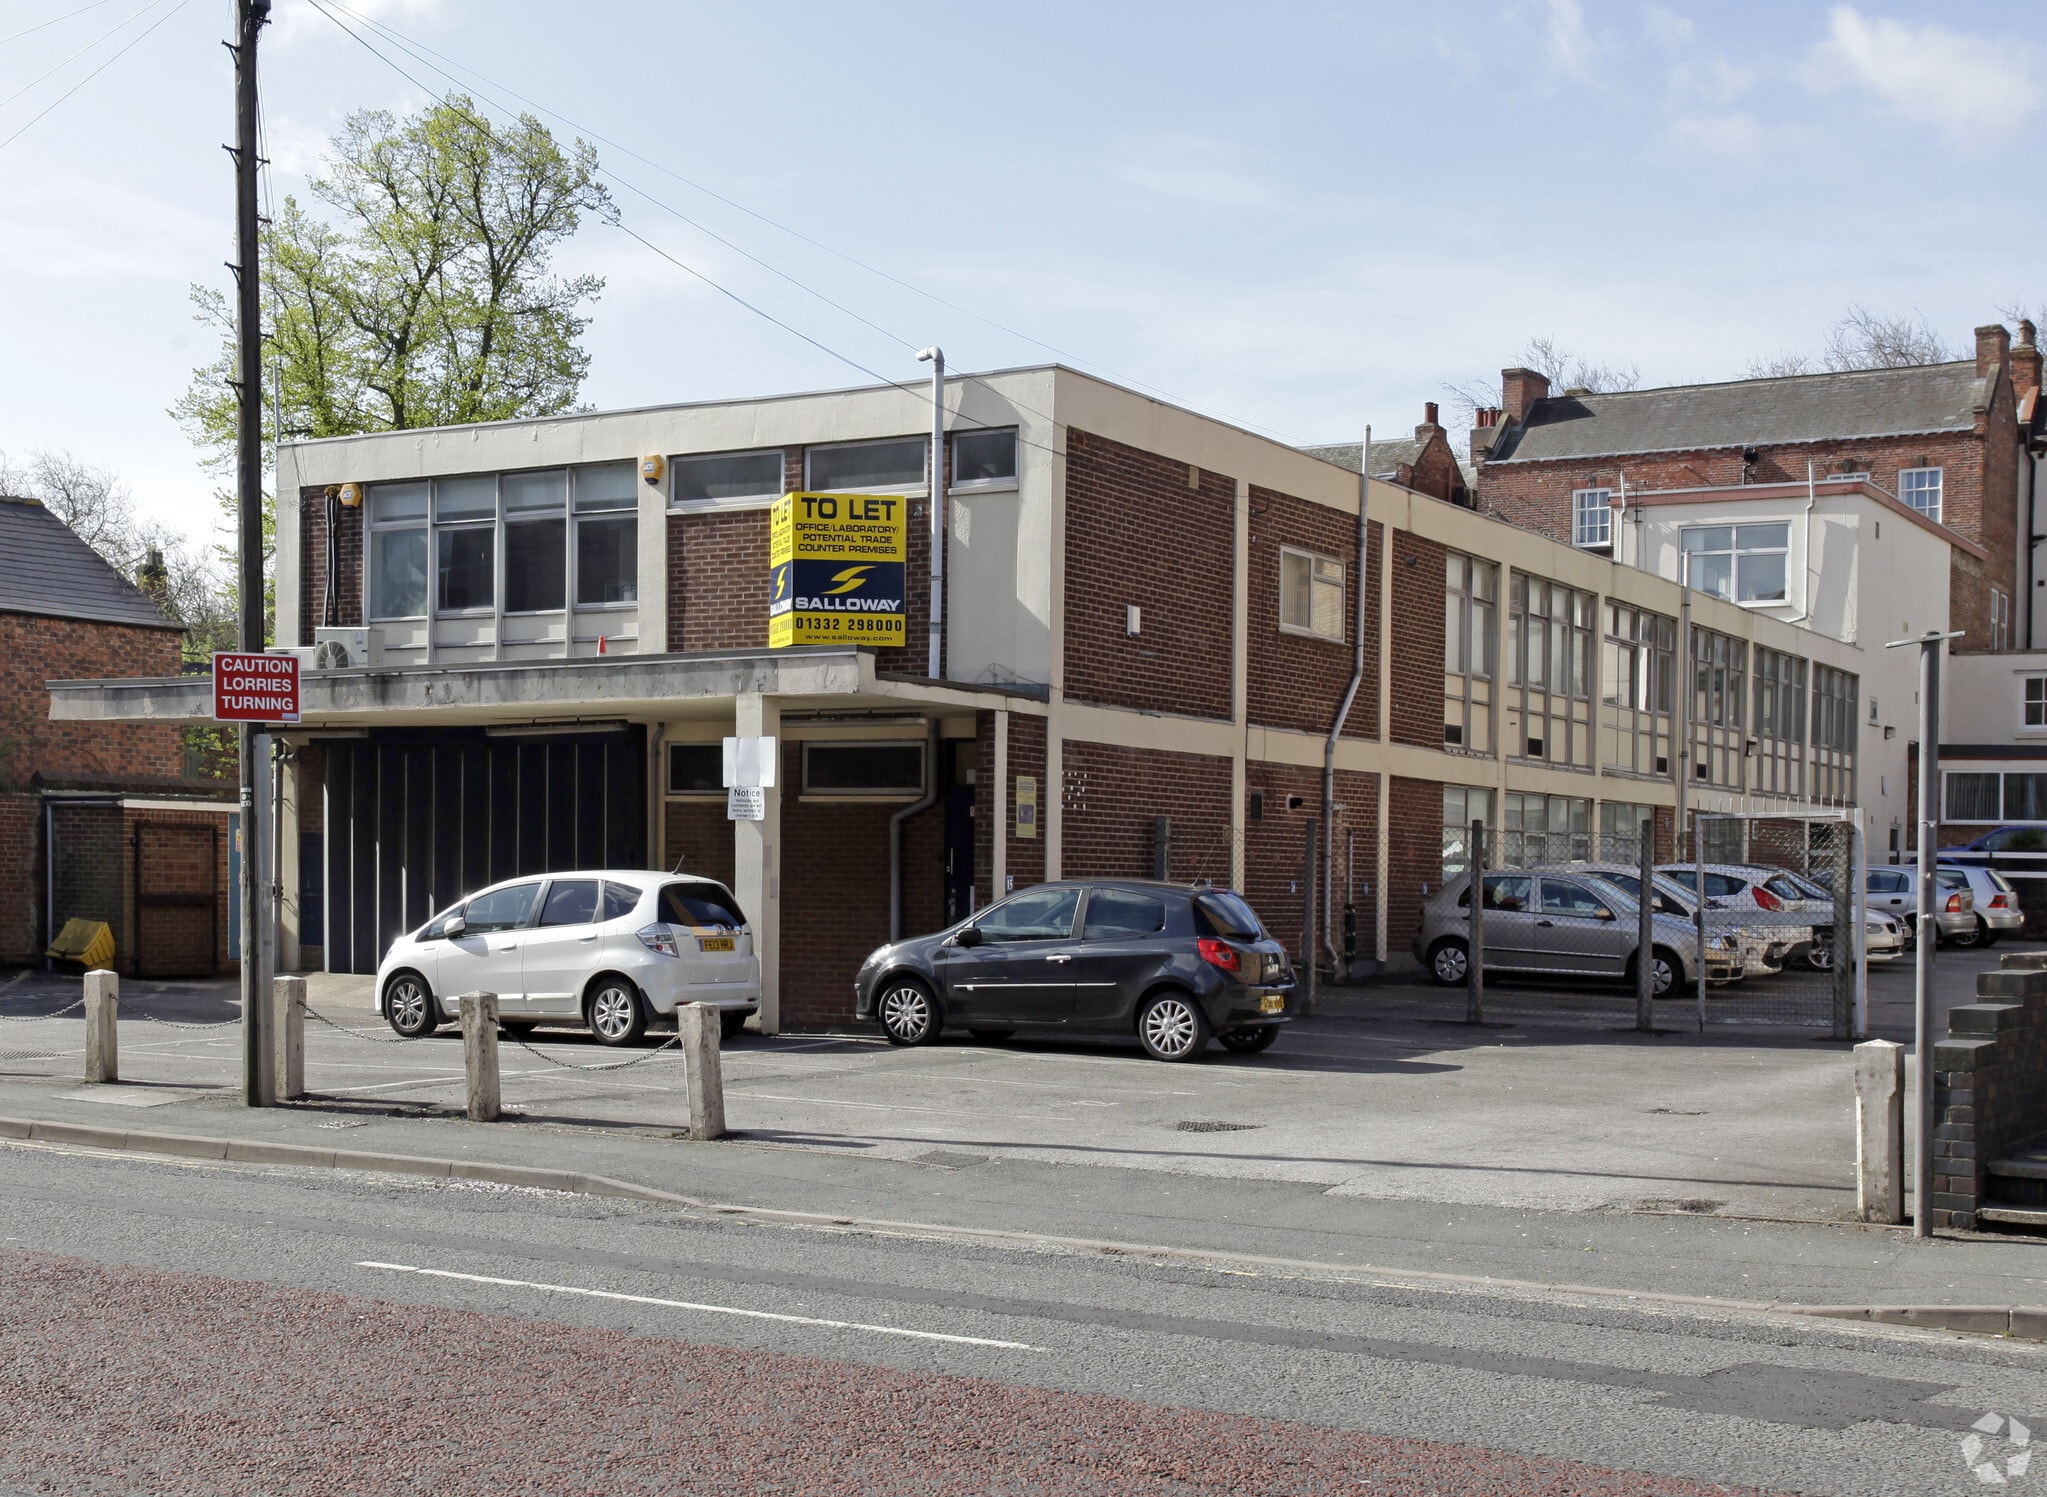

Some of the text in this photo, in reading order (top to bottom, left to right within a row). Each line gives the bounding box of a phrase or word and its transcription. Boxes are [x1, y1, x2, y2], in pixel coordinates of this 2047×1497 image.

[801, 497, 897, 521] TO LET
[803, 534, 893, 544] POTENTIAL TRADE
[798, 543, 845, 553] COUNTER
[848, 545, 897, 554] PREMISES
[795, 596, 901, 611] SALLOWAY
[796, 617, 840, 630] 01332
[848, 618, 902, 632] 298000
[805, 634, 893, 642] www.salloway.com
[221, 658, 293, 673] CAUTION
[223, 677, 292, 692] LORRIES
[221, 695, 293, 710] TURNING
[734, 789, 760, 797] Notice
